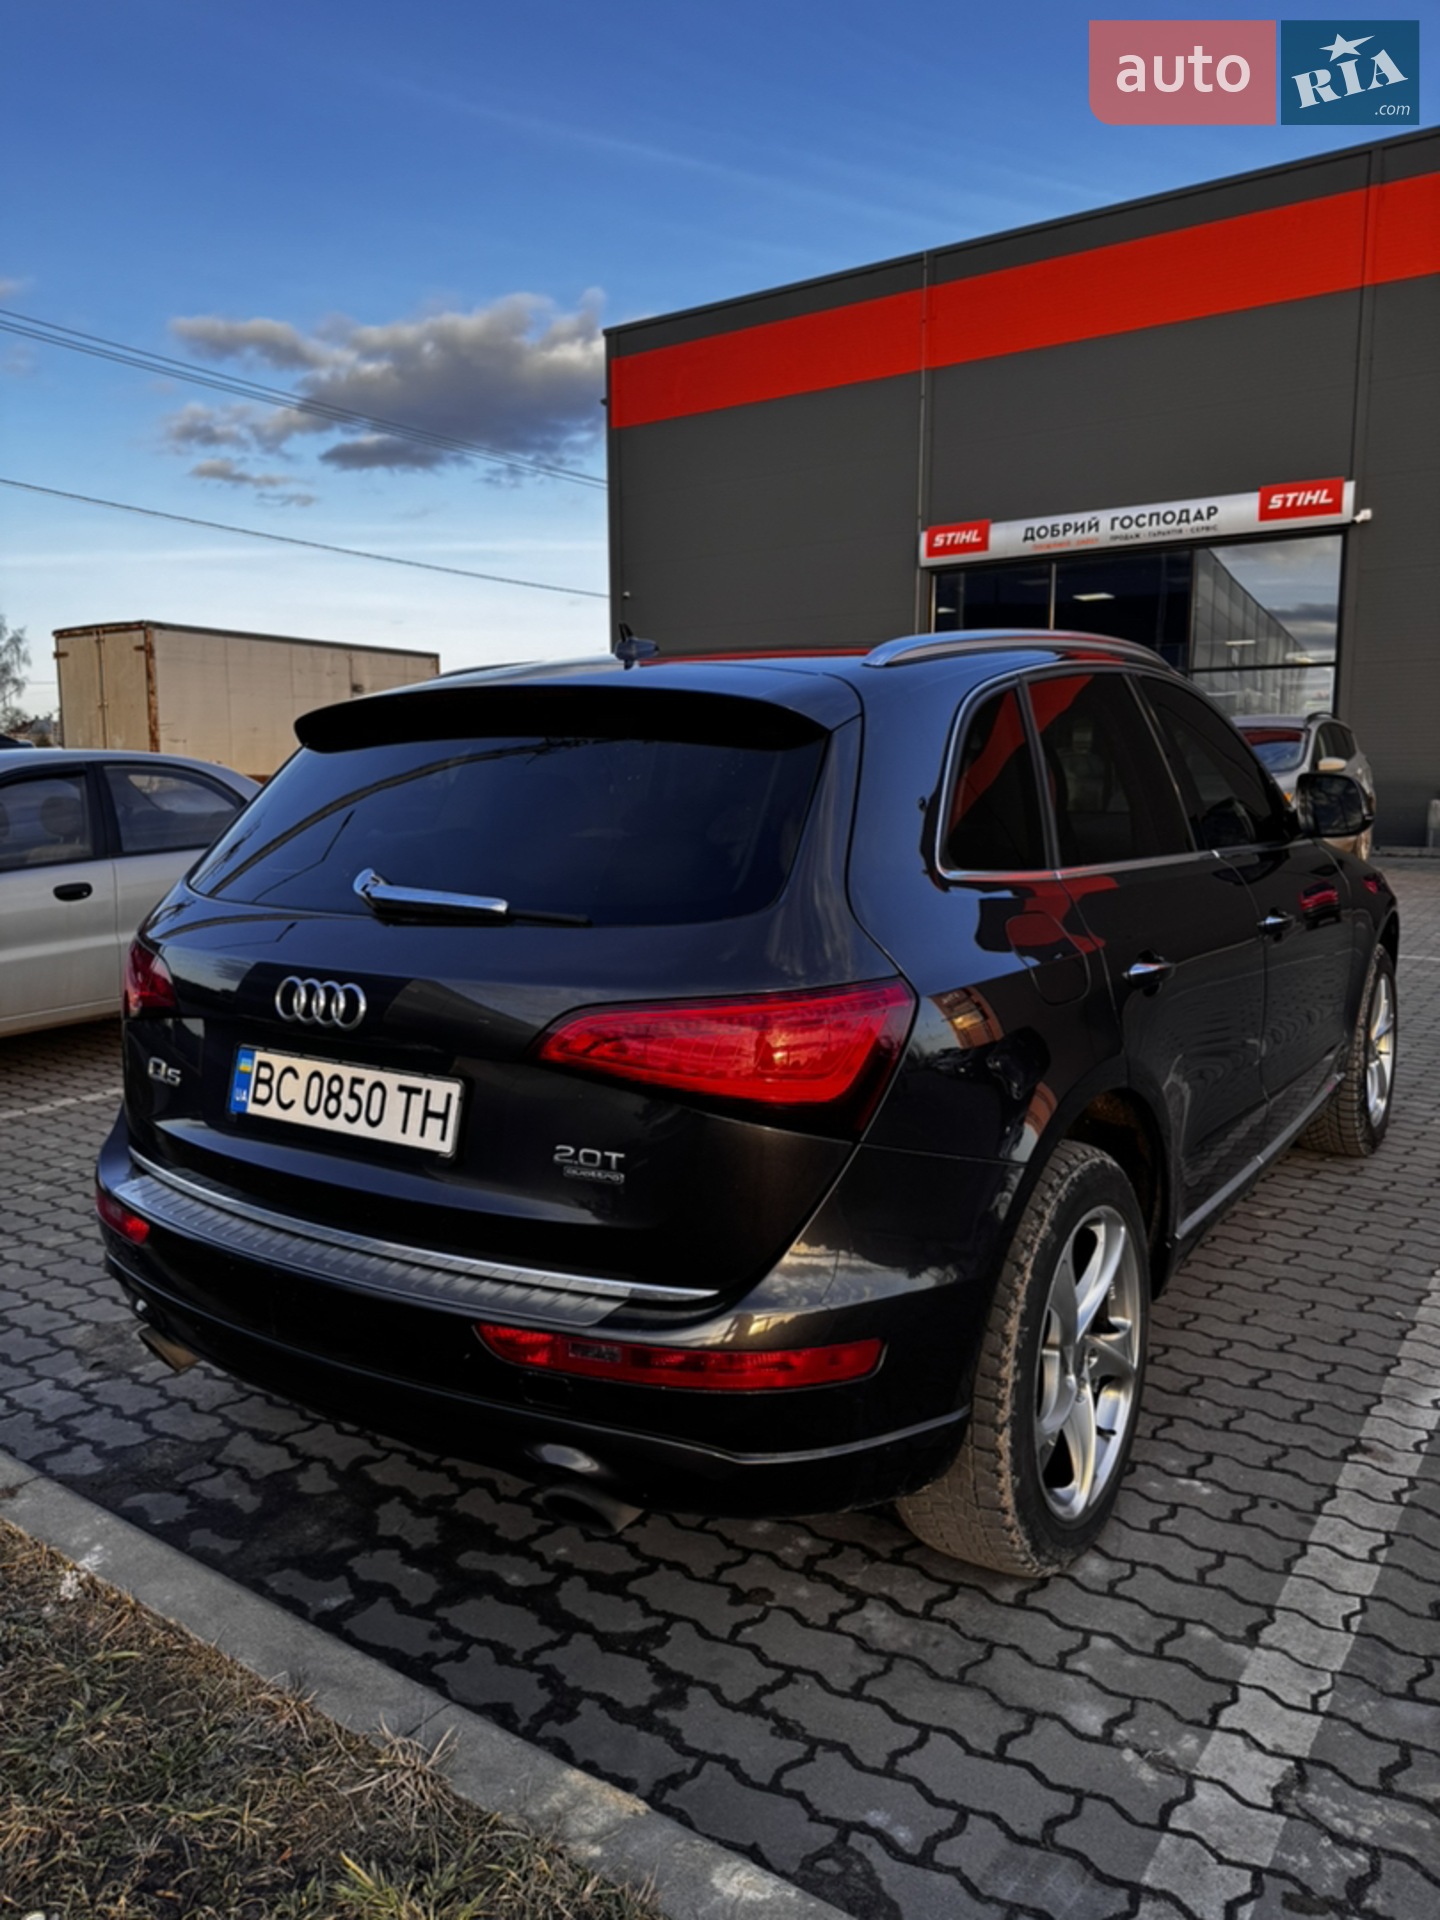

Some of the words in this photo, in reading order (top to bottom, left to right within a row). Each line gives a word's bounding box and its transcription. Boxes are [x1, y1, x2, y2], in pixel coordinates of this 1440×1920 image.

[1267, 488, 1334, 510] STIHL
[932, 529, 982, 548] STIHL
[1022, 516, 1100, 543] ДОБРИЙ
[1110, 505, 1219, 531] ГОСПОДАР
[148, 1056, 181, 1086] Q5
[251, 1060, 299, 1111] BC
[303, 1069, 387, 1129] 0850
[397, 1083, 453, 1142] TH
